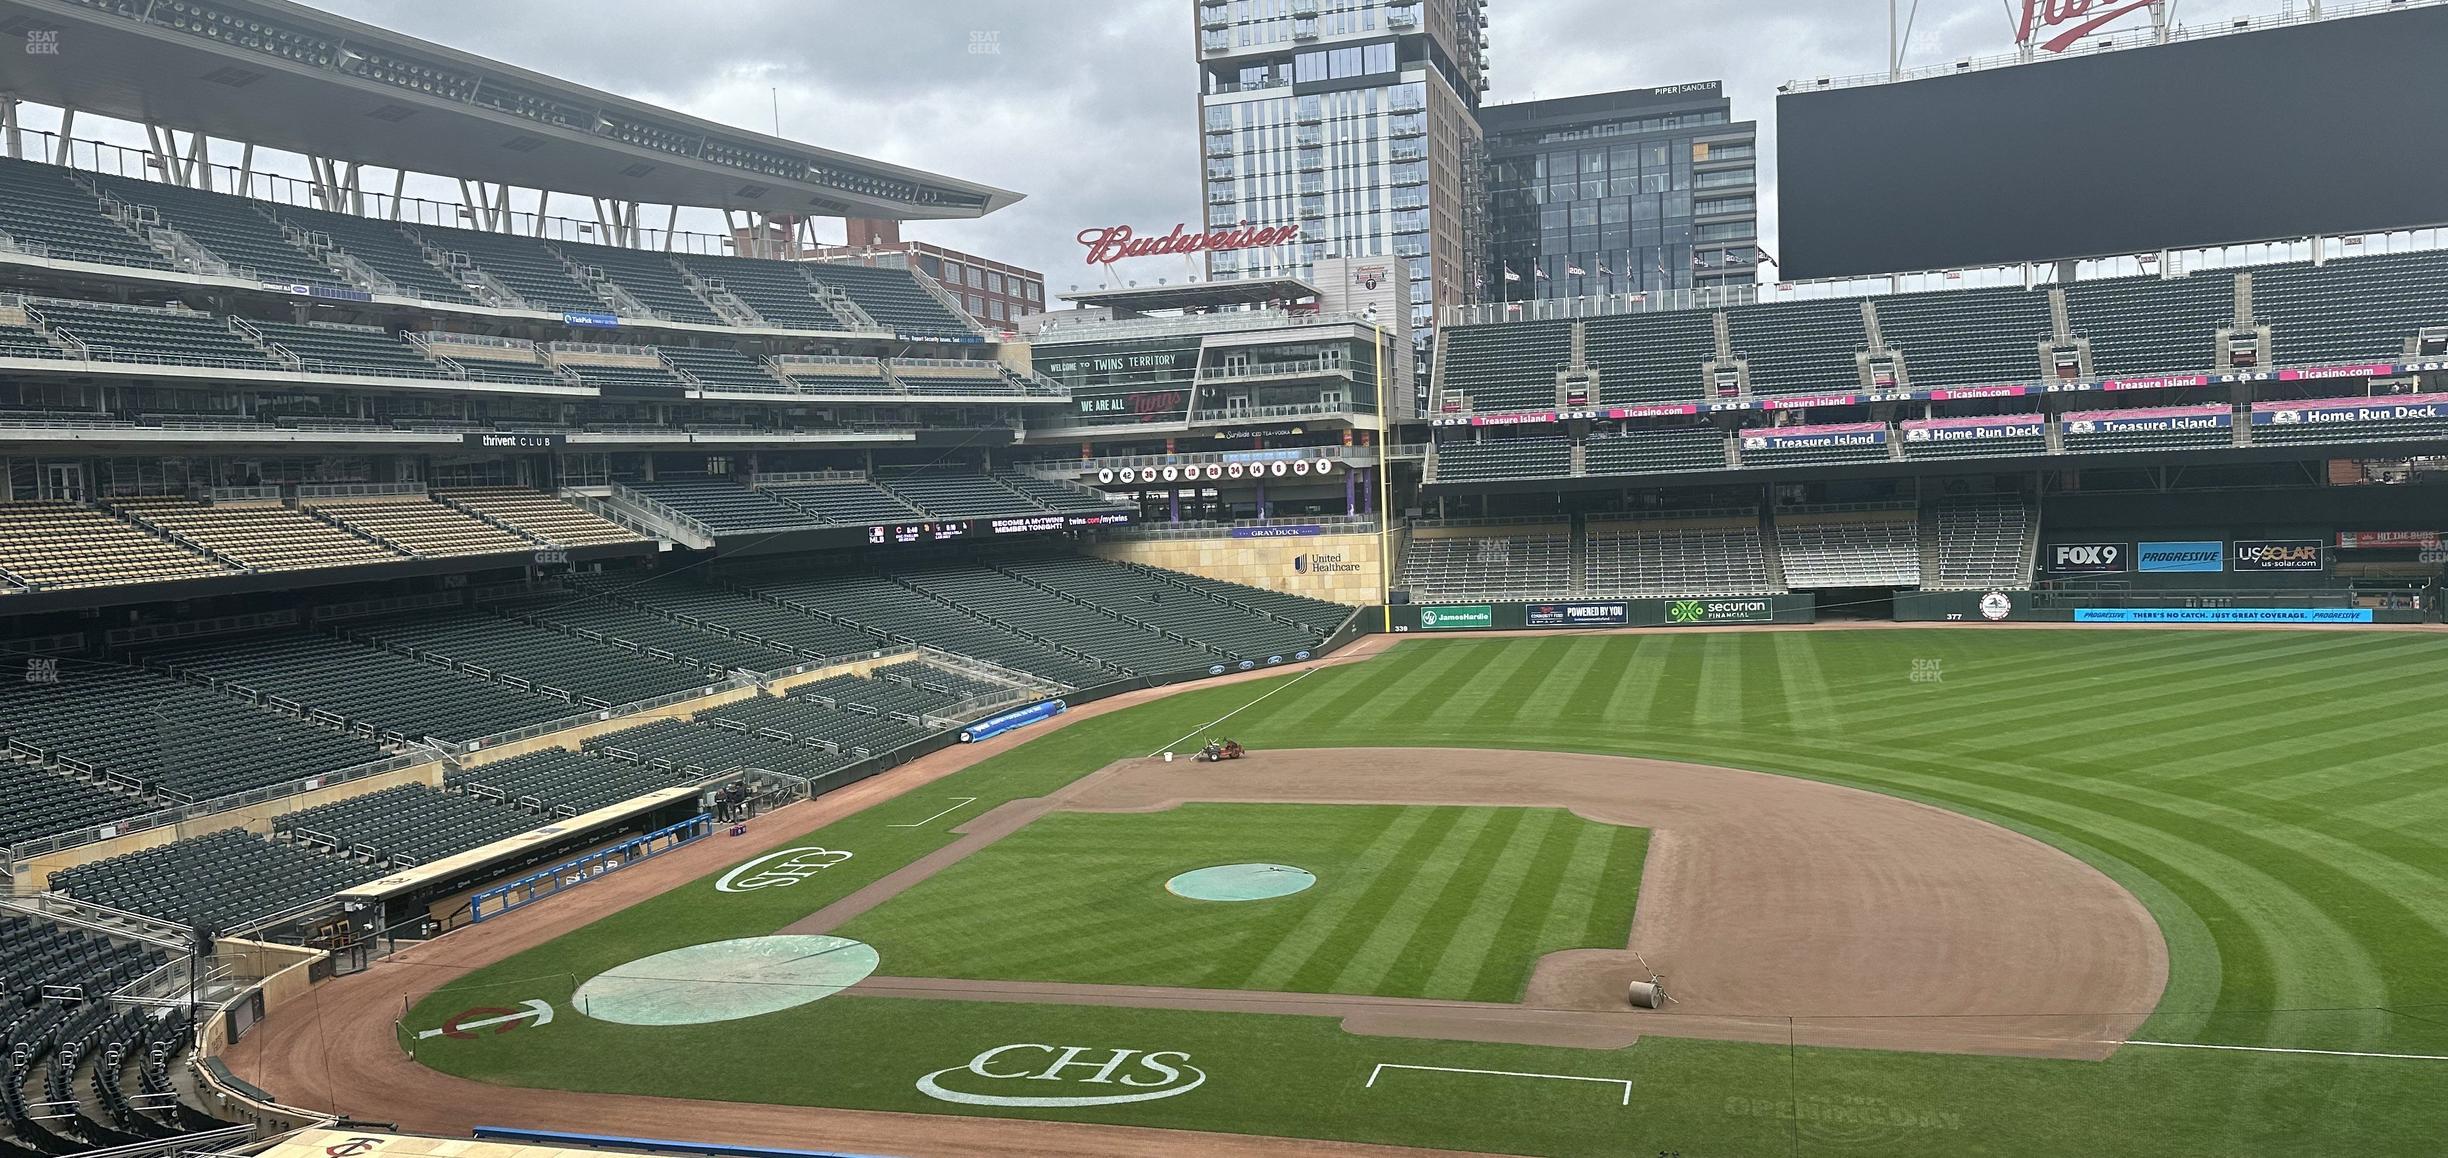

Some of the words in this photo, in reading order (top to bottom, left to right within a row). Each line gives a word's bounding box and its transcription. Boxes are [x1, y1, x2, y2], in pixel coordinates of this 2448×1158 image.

[1655, 87, 1677, 95] PIPER
[1681, 82, 1717, 92] SANDLER
[1077, 219, 1298, 265] Budweiser
[1050, 362, 1077, 372] WELCOME
[1094, 358, 1123, 371] TWINS
[1129, 354, 1176, 367] TERRITORY
[2114, 380, 2161, 390] Treasure
[2164, 377, 2197, 387] Island
[1081, 400, 1093, 412] WE
[1095, 400, 1109, 411] ARE
[1111, 399, 1124, 410] ALL
[1128, 392, 1181, 423] Twins
[1773, 400, 1815, 409] Treasure
[1817, 397, 1846, 406] Island
[1480, 416, 1518, 426] Treasure
[1520, 414, 1547, 423] Island
[2307, 411, 2356, 423] Home
[2358, 409, 2391, 421] Run
[2395, 405, 2437, 418] Deck
[2104, 420, 2170, 432] Treasure
[2171, 416, 2217, 429] Island
[1934, 429, 1972, 441] Home
[1976, 427, 2002, 438] Run
[2006, 424, 2039, 437] Deck
[483, 435, 516, 446] thrivent
[520, 437, 550, 446] CLUB
[1773, 437, 1832, 448] Treasure
[1834, 433, 1875, 446] Island
[1253, 466, 1261, 474] 14
[991, 519, 1024, 528] BECOME
[994, 525, 1027, 534] MEMBER
[1028, 523, 1063, 532] TONIGHT!
[869, 536, 884, 544] MLB
[1312, 553, 1341, 563] United
[2057, 546, 2101, 565] FOX
[2102, 546, 2118, 564] 9
[2142, 552, 2219, 562] PROGRESSIVE
[1312, 563, 1360, 572] Healthcare
[1567, 606, 1599, 617] POWERED
[1600, 606, 1609, 616] BY
[1610, 606, 1623, 616] YOU
[1708, 601, 1765, 612] securian
[1438, 613, 1489, 621] JamesHardie
[737, 849, 854, 888] CHS
[969, 1043, 1191, 1087] CHS
